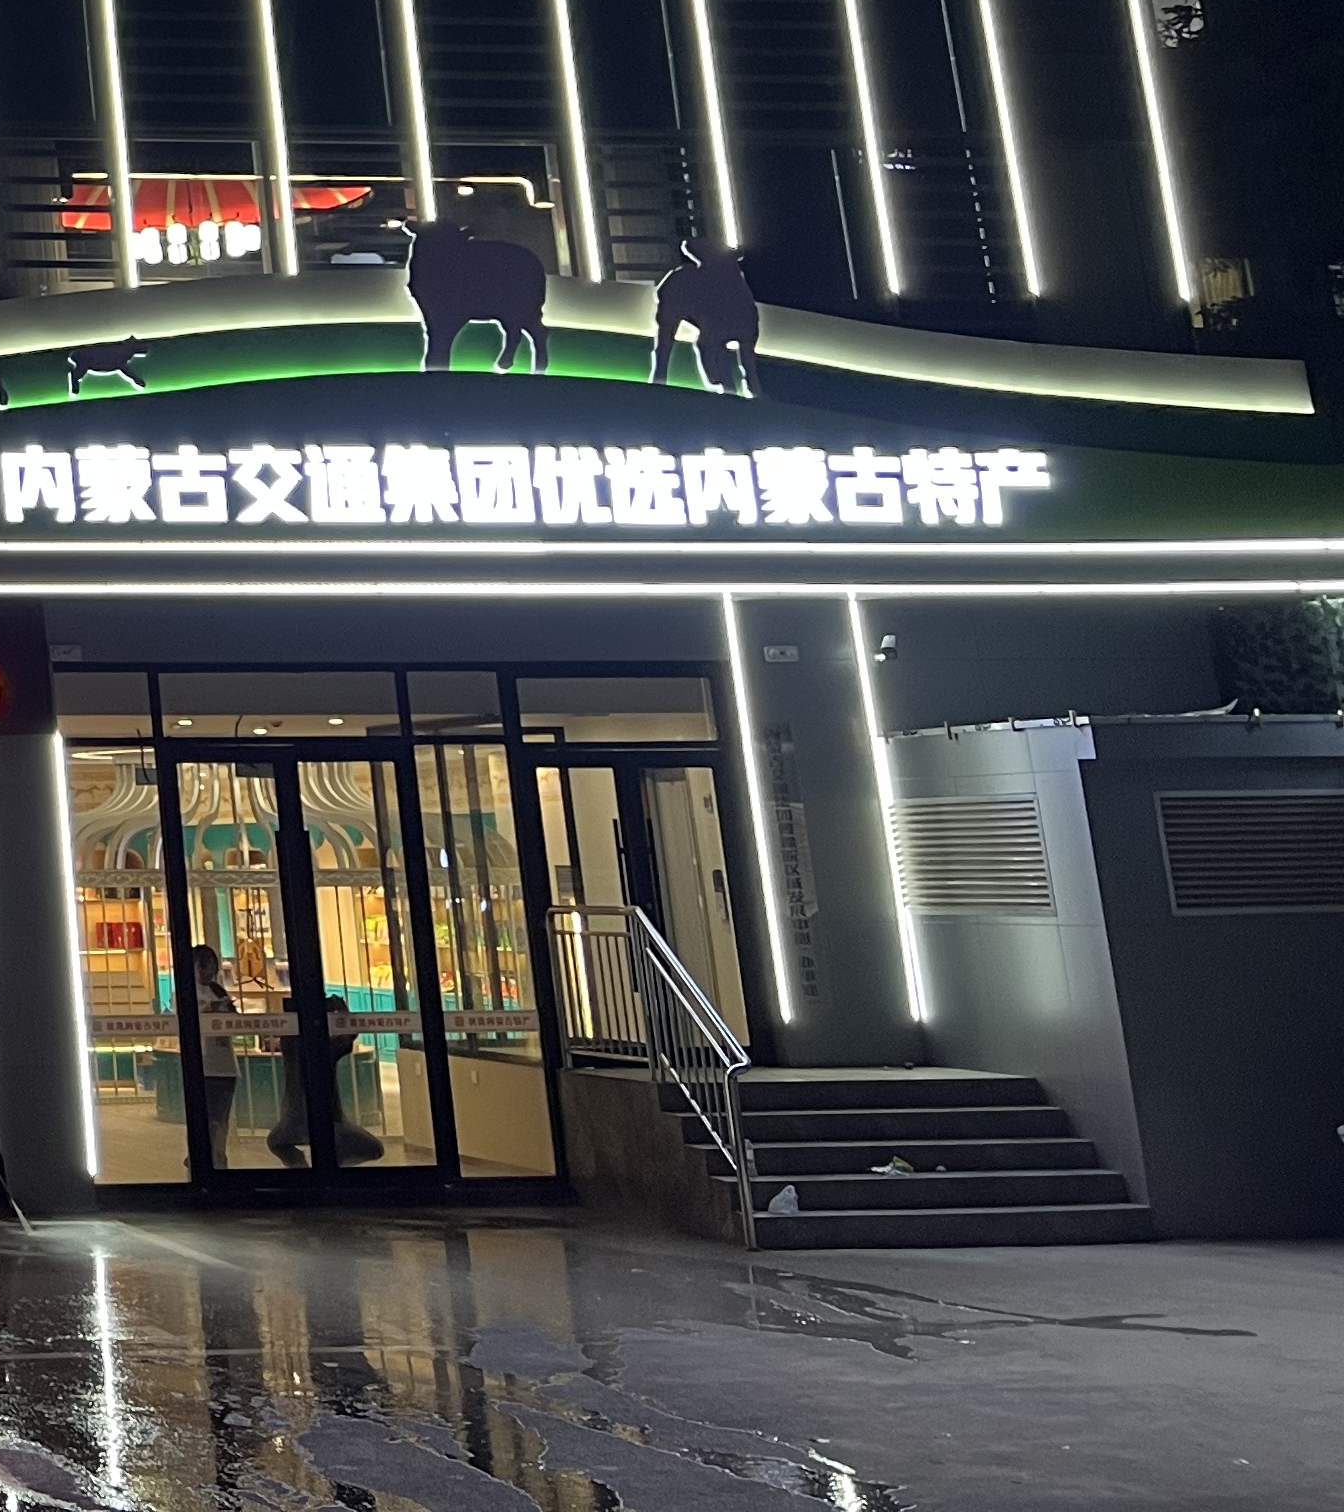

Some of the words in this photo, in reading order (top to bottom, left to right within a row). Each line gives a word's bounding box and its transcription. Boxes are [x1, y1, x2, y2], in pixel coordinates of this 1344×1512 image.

[0, 443, 1051, 526] 内蒙古交通集团优选内蒙古特产
